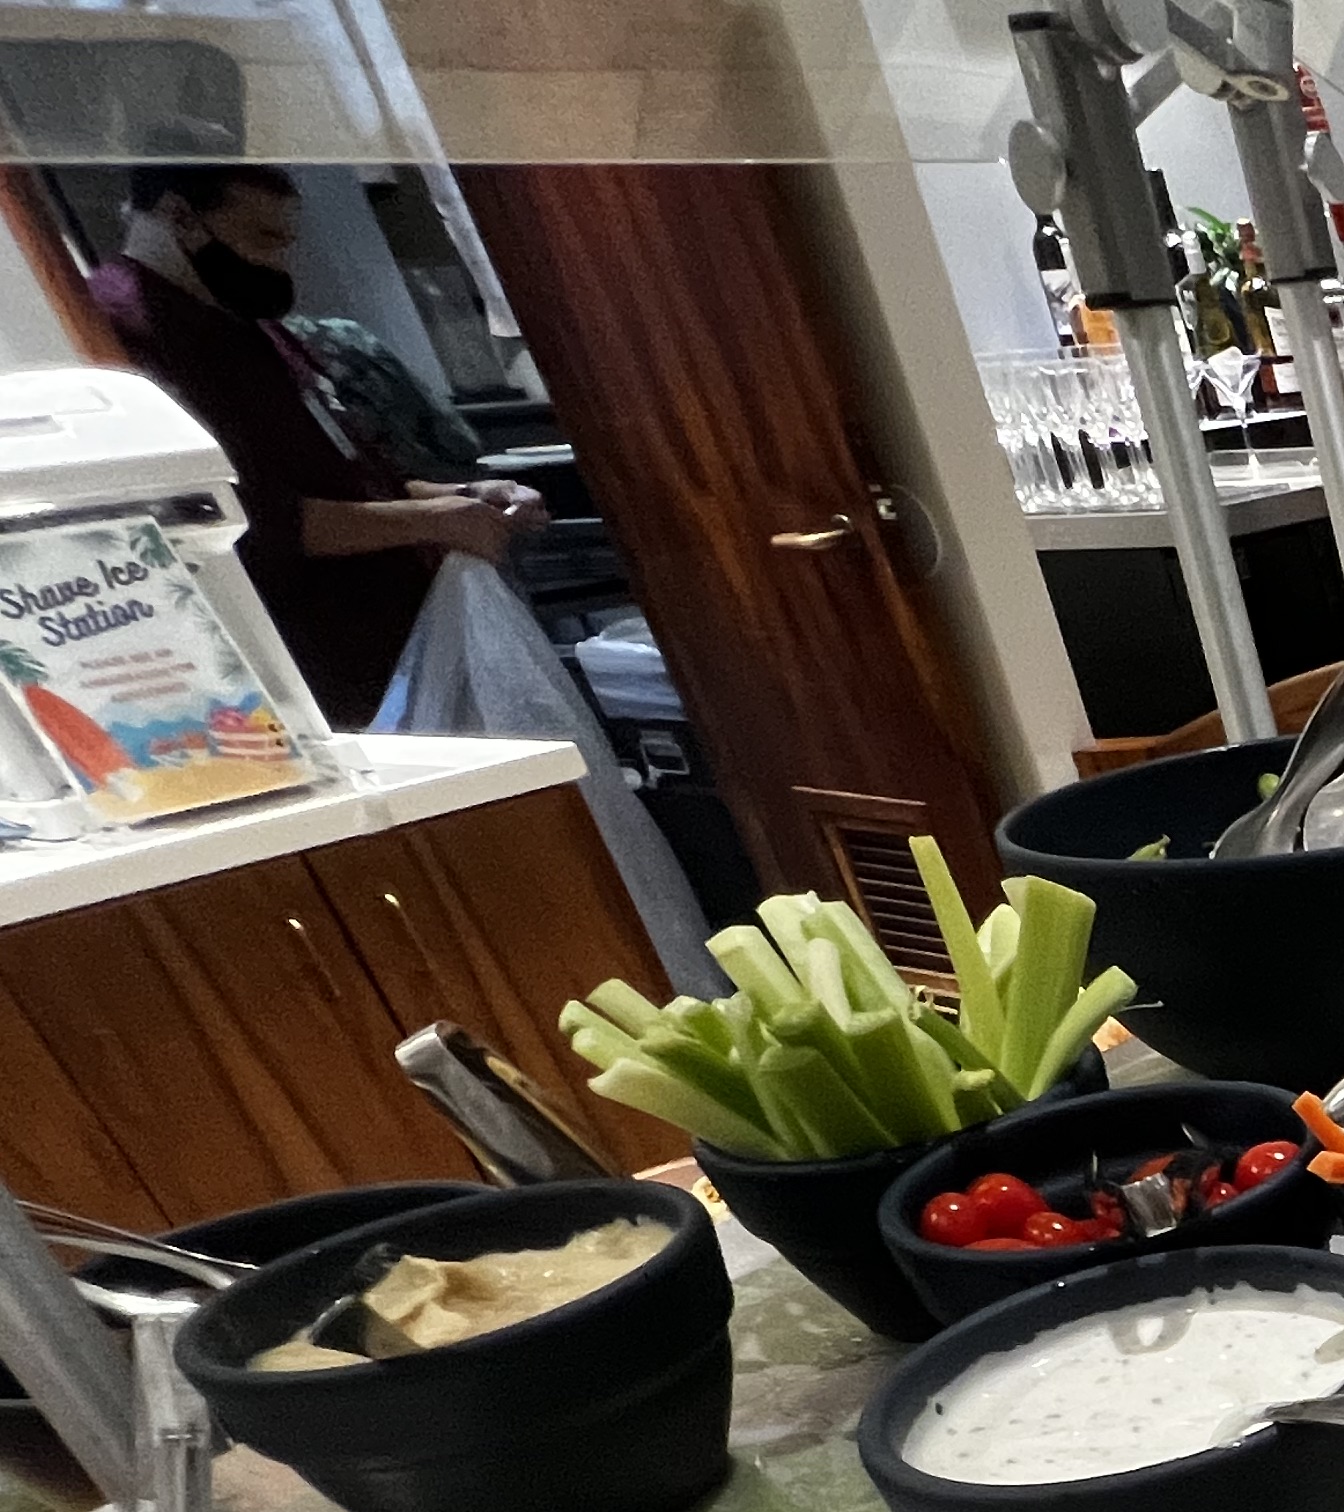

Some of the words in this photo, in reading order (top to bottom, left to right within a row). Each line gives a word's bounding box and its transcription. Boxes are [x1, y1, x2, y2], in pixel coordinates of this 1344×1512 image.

[0, 576, 100, 619] Shave
[96, 559, 149, 589] Ice
[38, 599, 154, 647] Station
